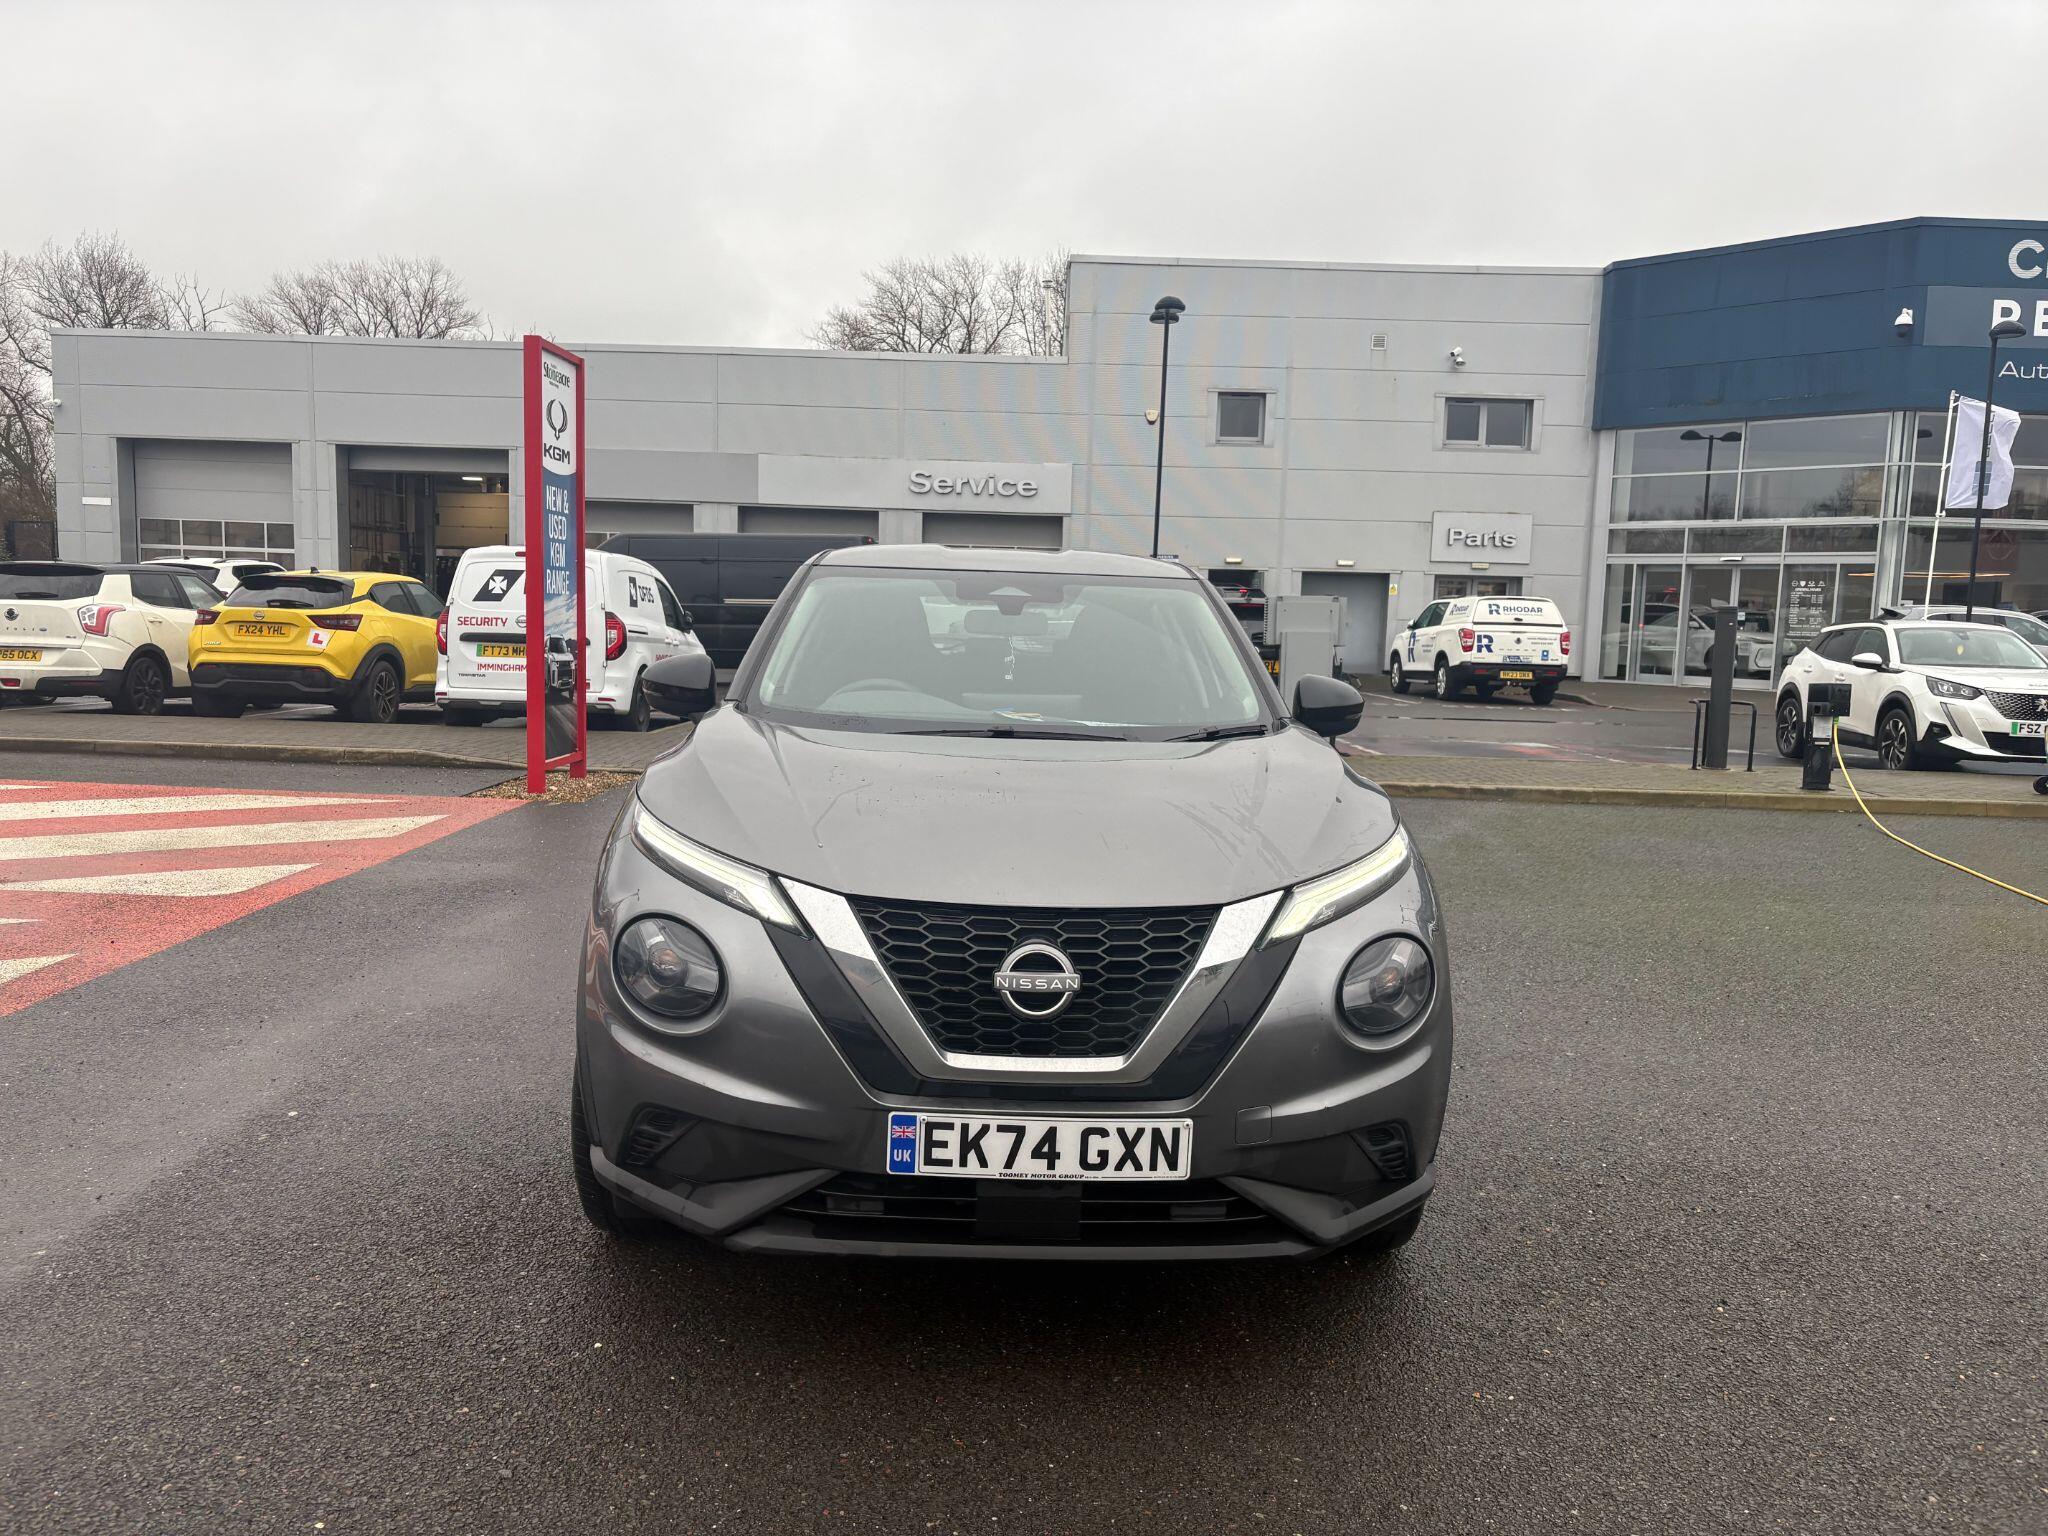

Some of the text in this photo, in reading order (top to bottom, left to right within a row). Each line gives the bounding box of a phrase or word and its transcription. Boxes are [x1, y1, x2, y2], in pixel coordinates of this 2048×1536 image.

[2008, 239, 2048, 279] C
[543, 442, 570, 464] KGM
[909, 470, 1038, 497] Service
[546, 485, 569, 514] NEW &
[548, 514, 567, 540] USED
[1448, 528, 1517, 548] Parts
[550, 541, 566, 567] KGM
[546, 568, 570, 595] RANGE
[237, 625, 286, 636] FX24 YHL
[457, 616, 508, 627] SECURITY
[312, 632, 324, 645] L
[0, 650, 38, 660] 65 OCX
[482, 645, 527, 656] FT73 MH
[477, 663, 527, 671] IMMINGHAM
[995, 976, 1079, 989] NISSAN
[893, 1148, 912, 1163] UK
[923, 1121, 1181, 1172] EK74 GXN
